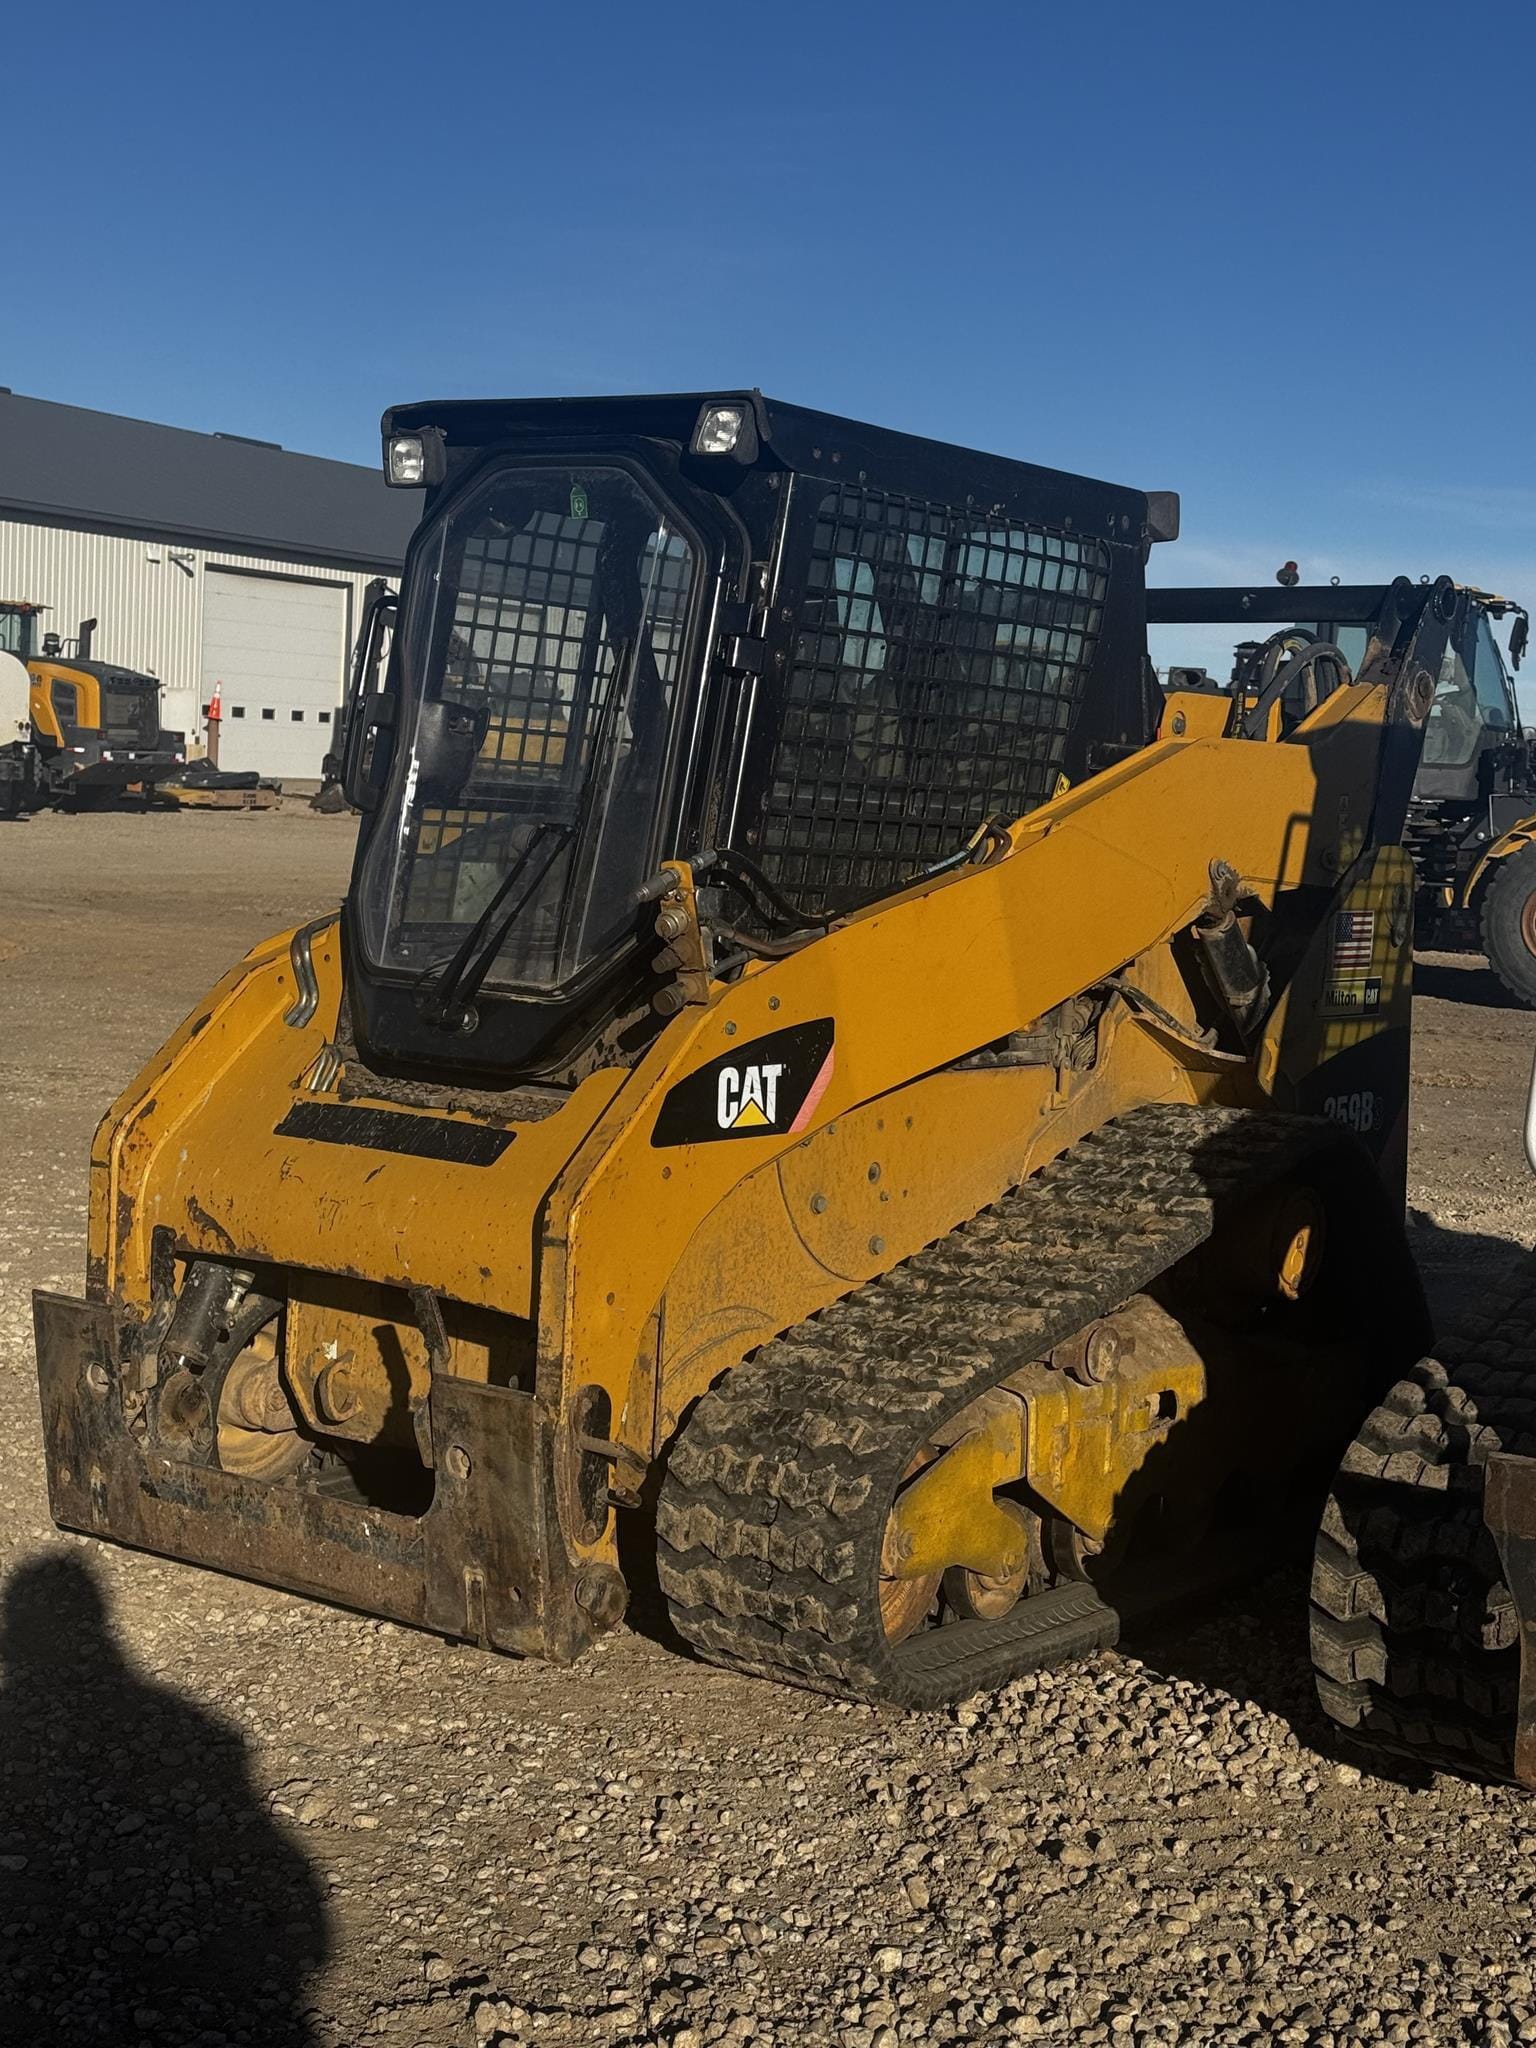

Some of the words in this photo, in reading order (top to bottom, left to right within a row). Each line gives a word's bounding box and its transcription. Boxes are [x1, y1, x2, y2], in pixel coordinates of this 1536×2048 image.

[1324, 990, 1357, 1008] Milton
[1365, 987, 1379, 1005] CAT
[716, 1063, 782, 1129] CAT
